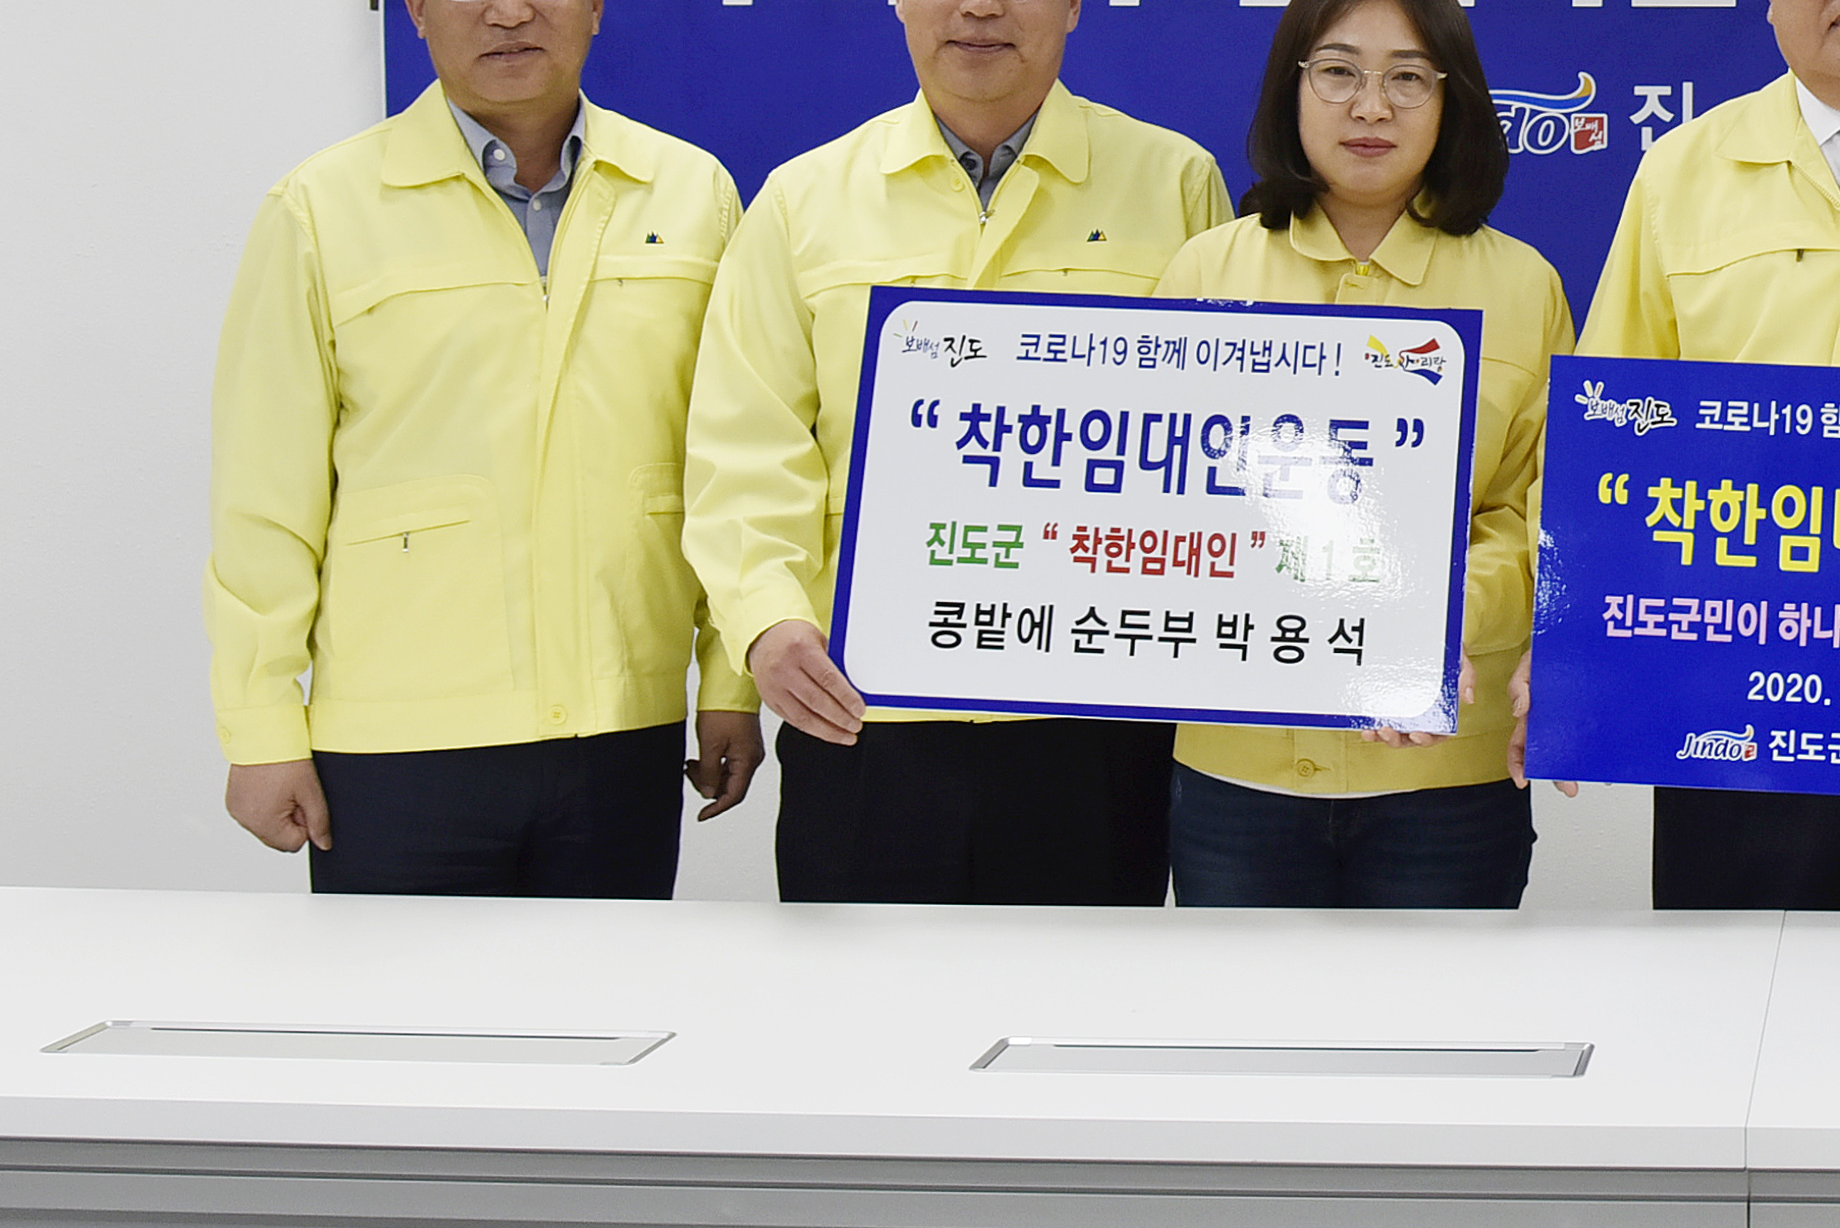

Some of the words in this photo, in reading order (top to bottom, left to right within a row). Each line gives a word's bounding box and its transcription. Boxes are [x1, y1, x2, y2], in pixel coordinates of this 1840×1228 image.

[943, 334, 988, 368] 진도
[1017, 333, 1127, 366] 코로나19
[1137, 335, 1187, 370] 함께
[1628, 397, 1677, 434] 진도
[1696, 401, 1812, 435] 코로나19
[927, 521, 1024, 569] 진도군
[929, 602, 1054, 652] 콩밭에
[1071, 606, 1196, 658] 순두부
[1603, 595, 1767, 644] 진도군민이
[1748, 672, 1830, 705] 2020.
[1677, 732, 1746, 760] Jindo
